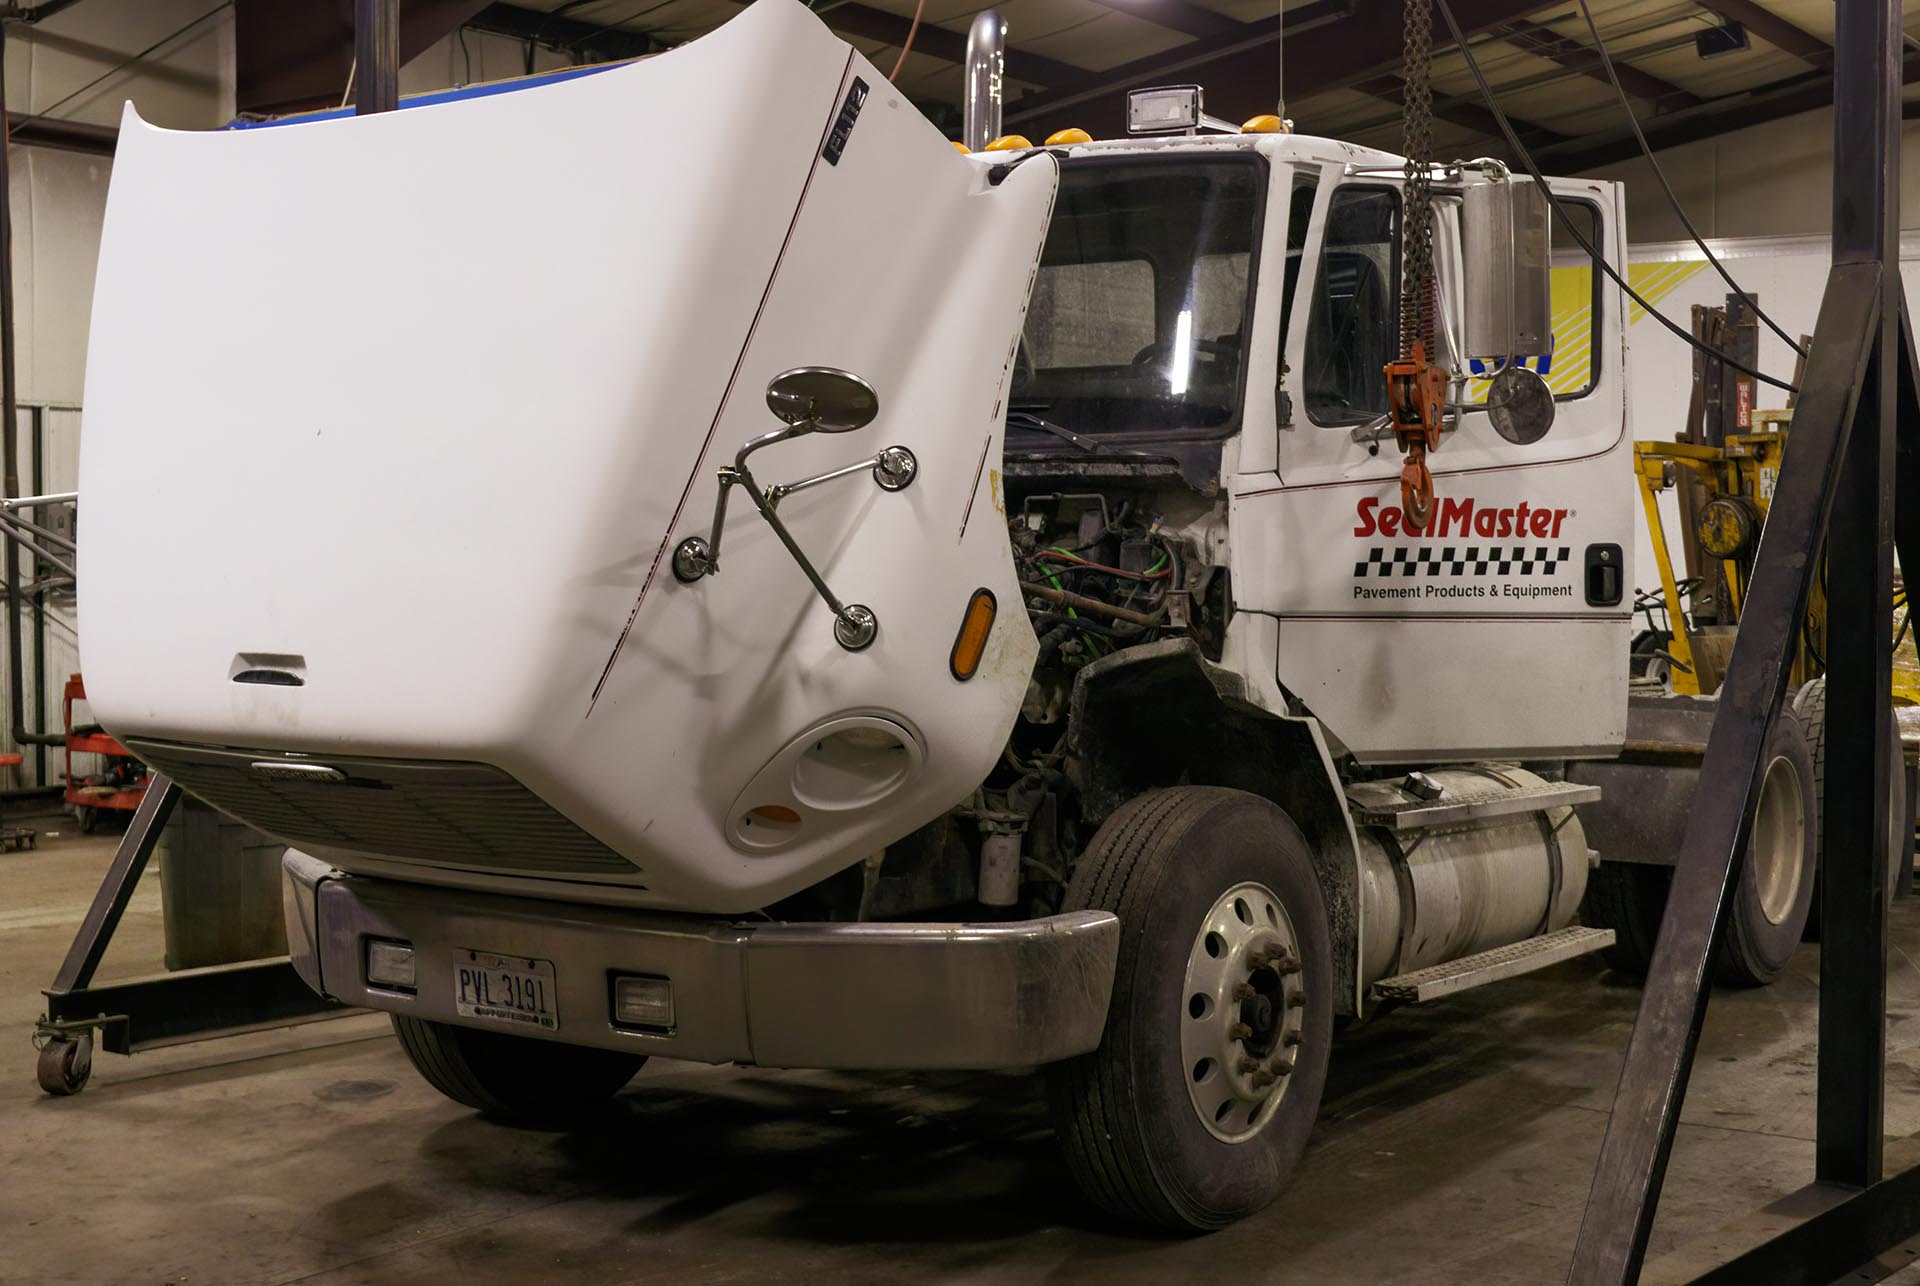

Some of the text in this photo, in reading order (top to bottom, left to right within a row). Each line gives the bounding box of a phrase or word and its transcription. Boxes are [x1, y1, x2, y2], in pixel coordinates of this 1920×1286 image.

[1354, 584, 1572, 599] Pavement Products & Equipment
[460, 968, 546, 1014] PVL 3191
